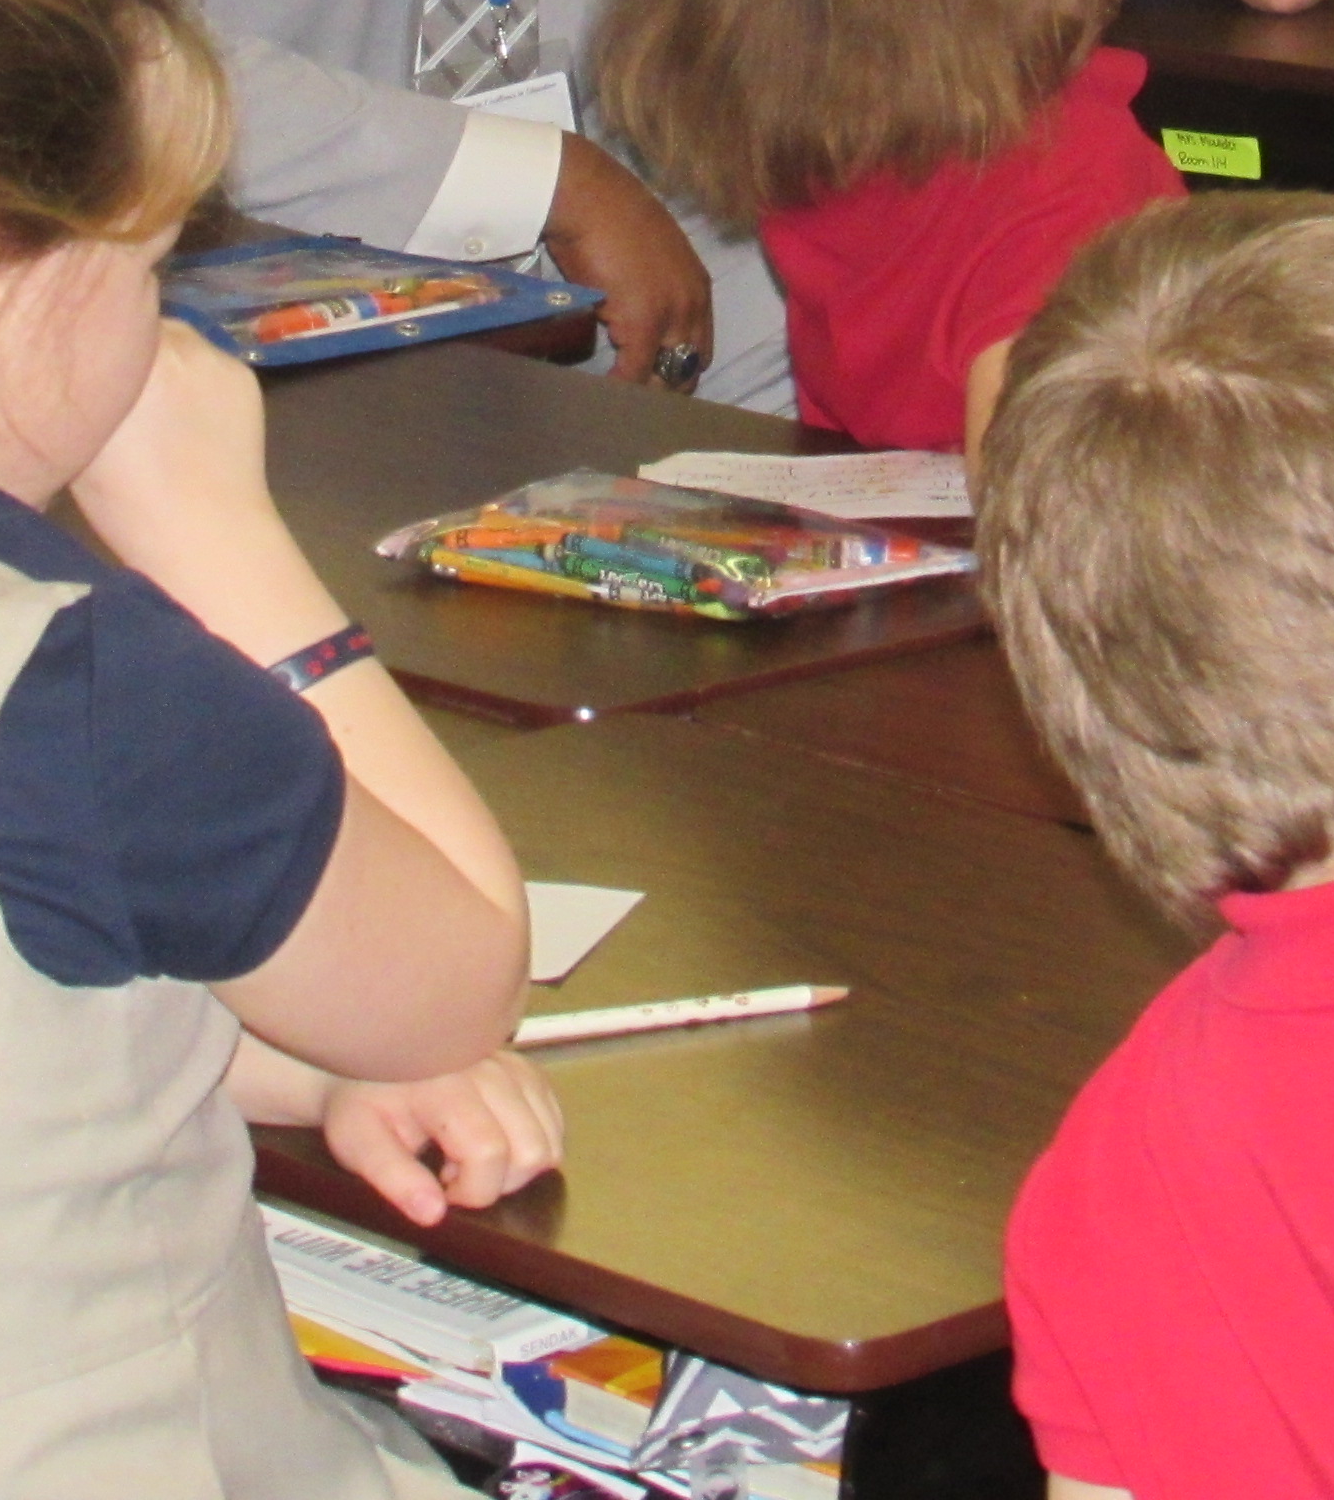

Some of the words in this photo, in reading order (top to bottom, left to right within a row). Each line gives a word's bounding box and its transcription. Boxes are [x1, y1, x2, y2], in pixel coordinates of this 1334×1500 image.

[1178, 151, 1208, 165] Room
[344, 1253, 429, 1286] THE
[518, 1326, 579, 1358] SENDAK
